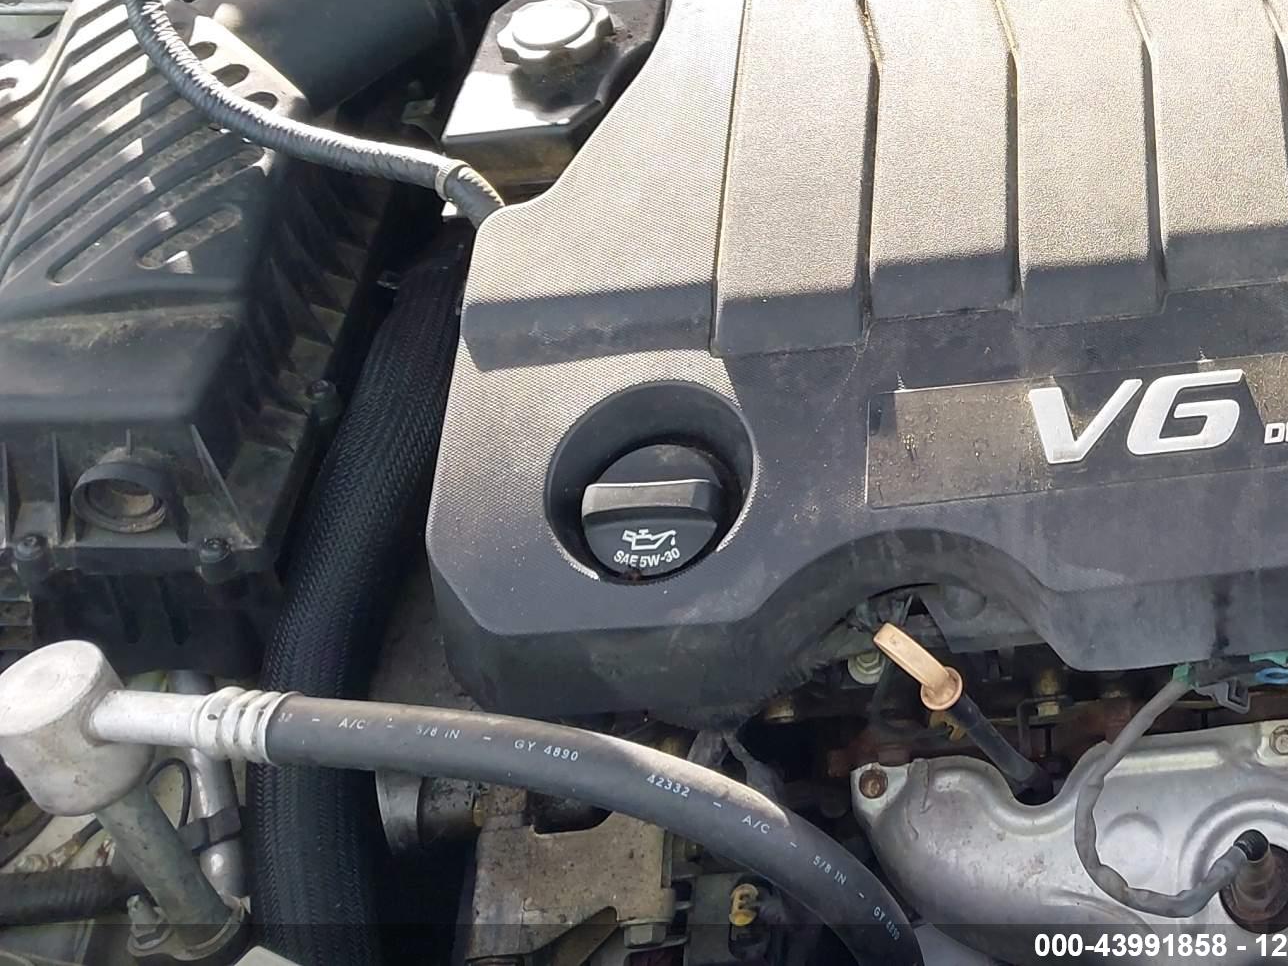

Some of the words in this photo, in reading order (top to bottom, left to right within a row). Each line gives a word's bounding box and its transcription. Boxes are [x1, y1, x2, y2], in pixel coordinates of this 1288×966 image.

[1029, 369, 1243, 464] V6
[613, 550, 638, 567] SAE
[639, 548, 680, 568] 5W-30
[338, 718, 365, 730] A/C
[444, 728, 460, 739] IN
[514, 739, 536, 752] GY
[543, 745, 579, 761] 4890
[646, 774, 691, 798] 42332
[742, 815, 771, 834] A/C
[813, 855, 832, 874] 5/8
[834, 871, 847, 886] IN
